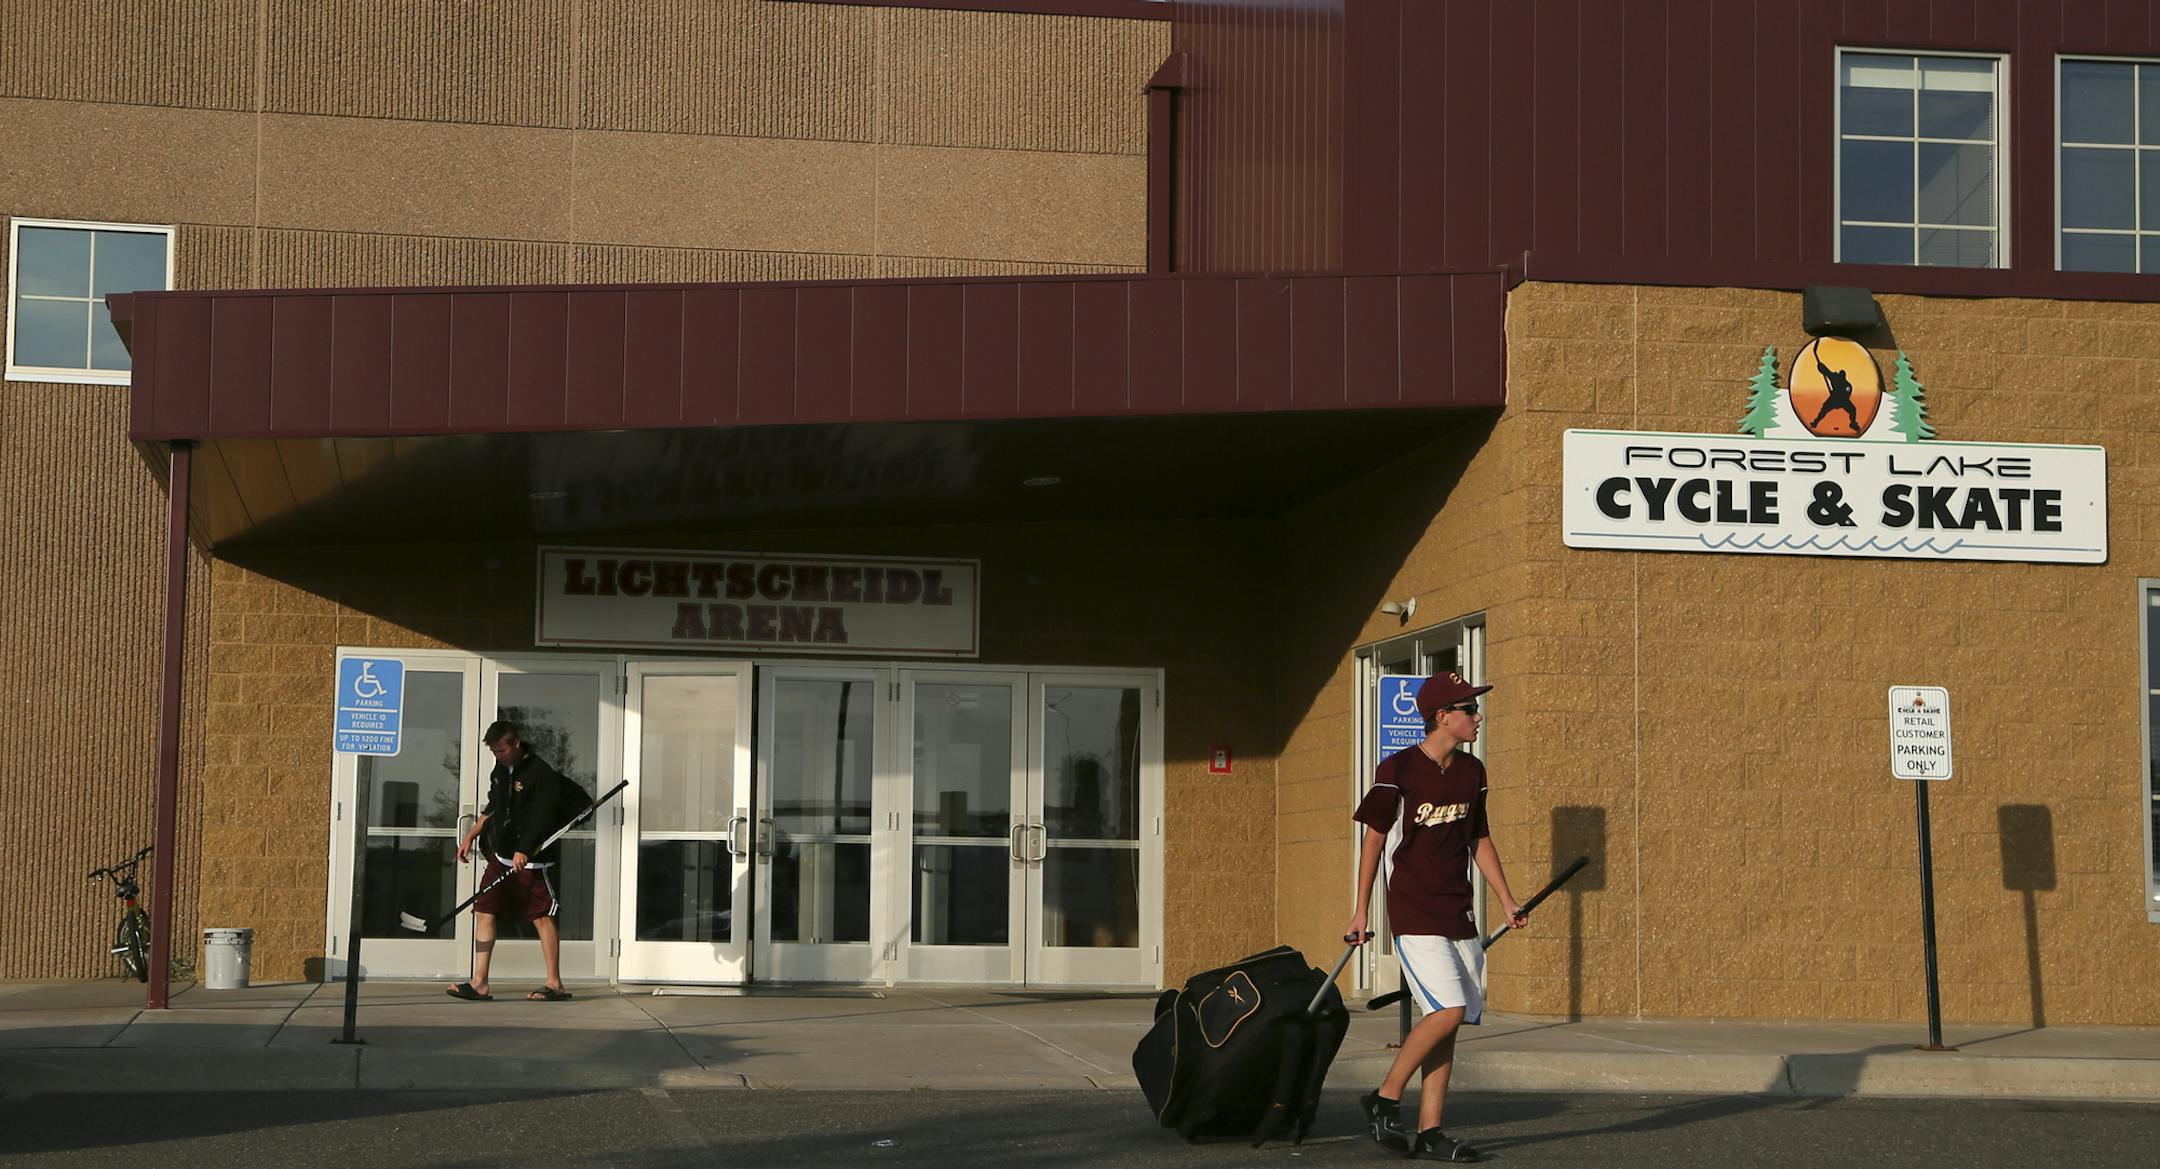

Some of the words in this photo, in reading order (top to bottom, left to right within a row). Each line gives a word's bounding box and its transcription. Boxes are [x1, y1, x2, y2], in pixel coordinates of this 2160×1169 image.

[1625, 445, 1866, 474] FOREST
[1889, 454, 2032, 478] LAKE
[1595, 475, 1780, 525] CYCLE
[1806, 480, 1858, 527] &
[1880, 484, 2063, 533] SKATE
[563, 558, 952, 606] LICHTSCHEIDL
[671, 602, 848, 643] ARENA
[355, 699, 384, 707] PARKING
[351, 713, 377, 721] VEHICLE
[1392, 716, 1424, 724] PARKING
[1904, 717, 1935, 726] RETAIL
[351, 721, 384, 729] REQUIRED
[1388, 729, 1417, 738] VEHICLE
[1896, 729, 1945, 738] CUSTOMER
[380, 736, 395, 744] FINE
[359, 743, 391, 752] VILATION
[1897, 745, 1945, 756] PARKING
[1906, 760, 1937, 771] ONLY
